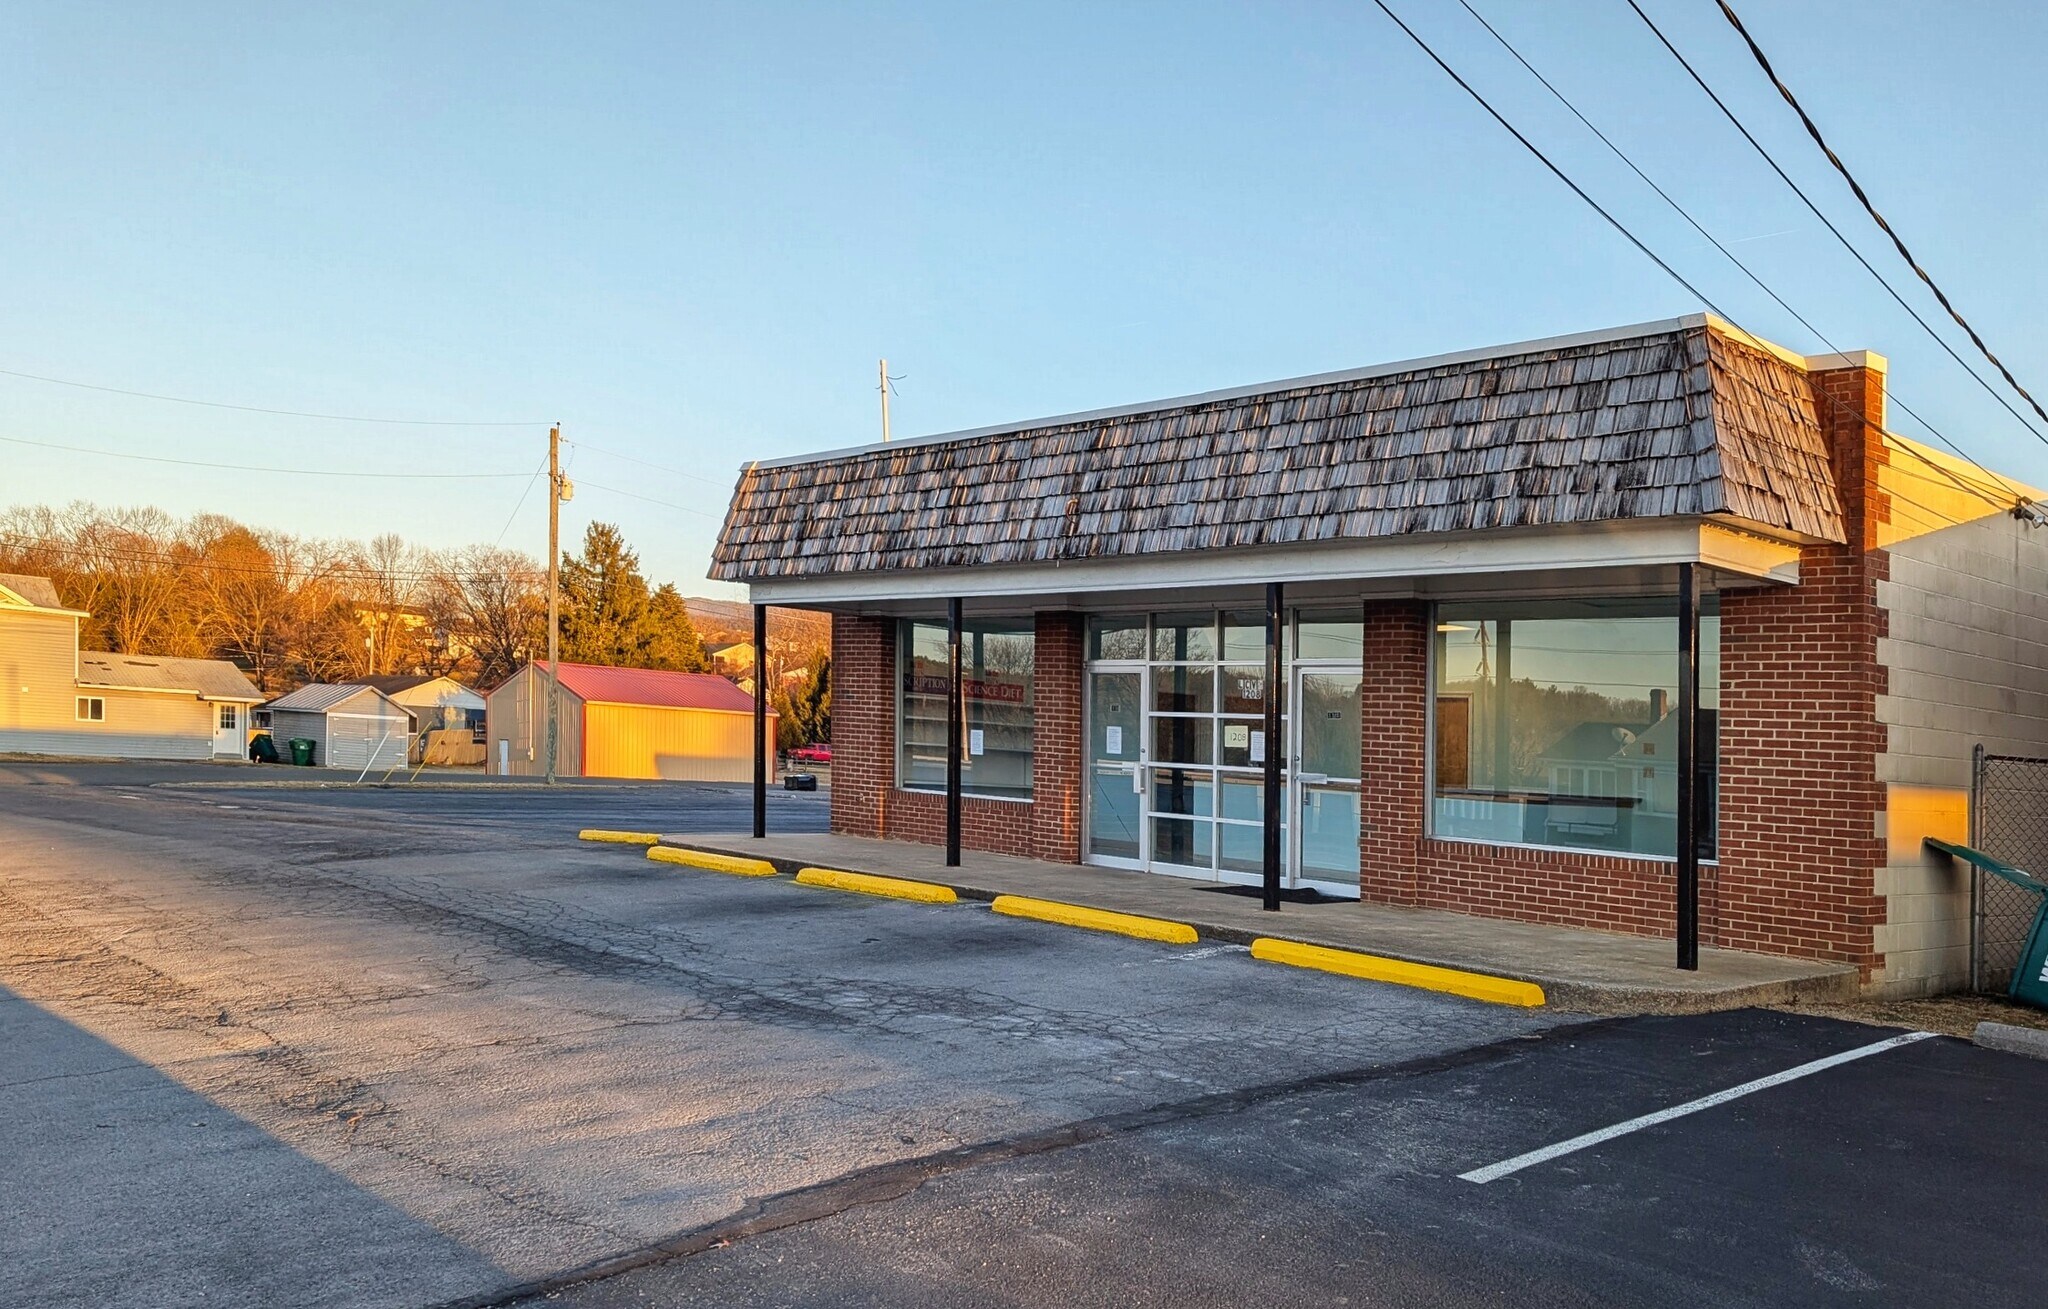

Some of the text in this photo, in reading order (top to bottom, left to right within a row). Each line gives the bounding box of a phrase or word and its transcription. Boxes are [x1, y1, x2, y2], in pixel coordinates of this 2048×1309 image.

[963, 682, 1022, 699] SCIENCE DIET
[1243, 690, 1261, 699] 1208
[1230, 732, 1247, 742] 1208
